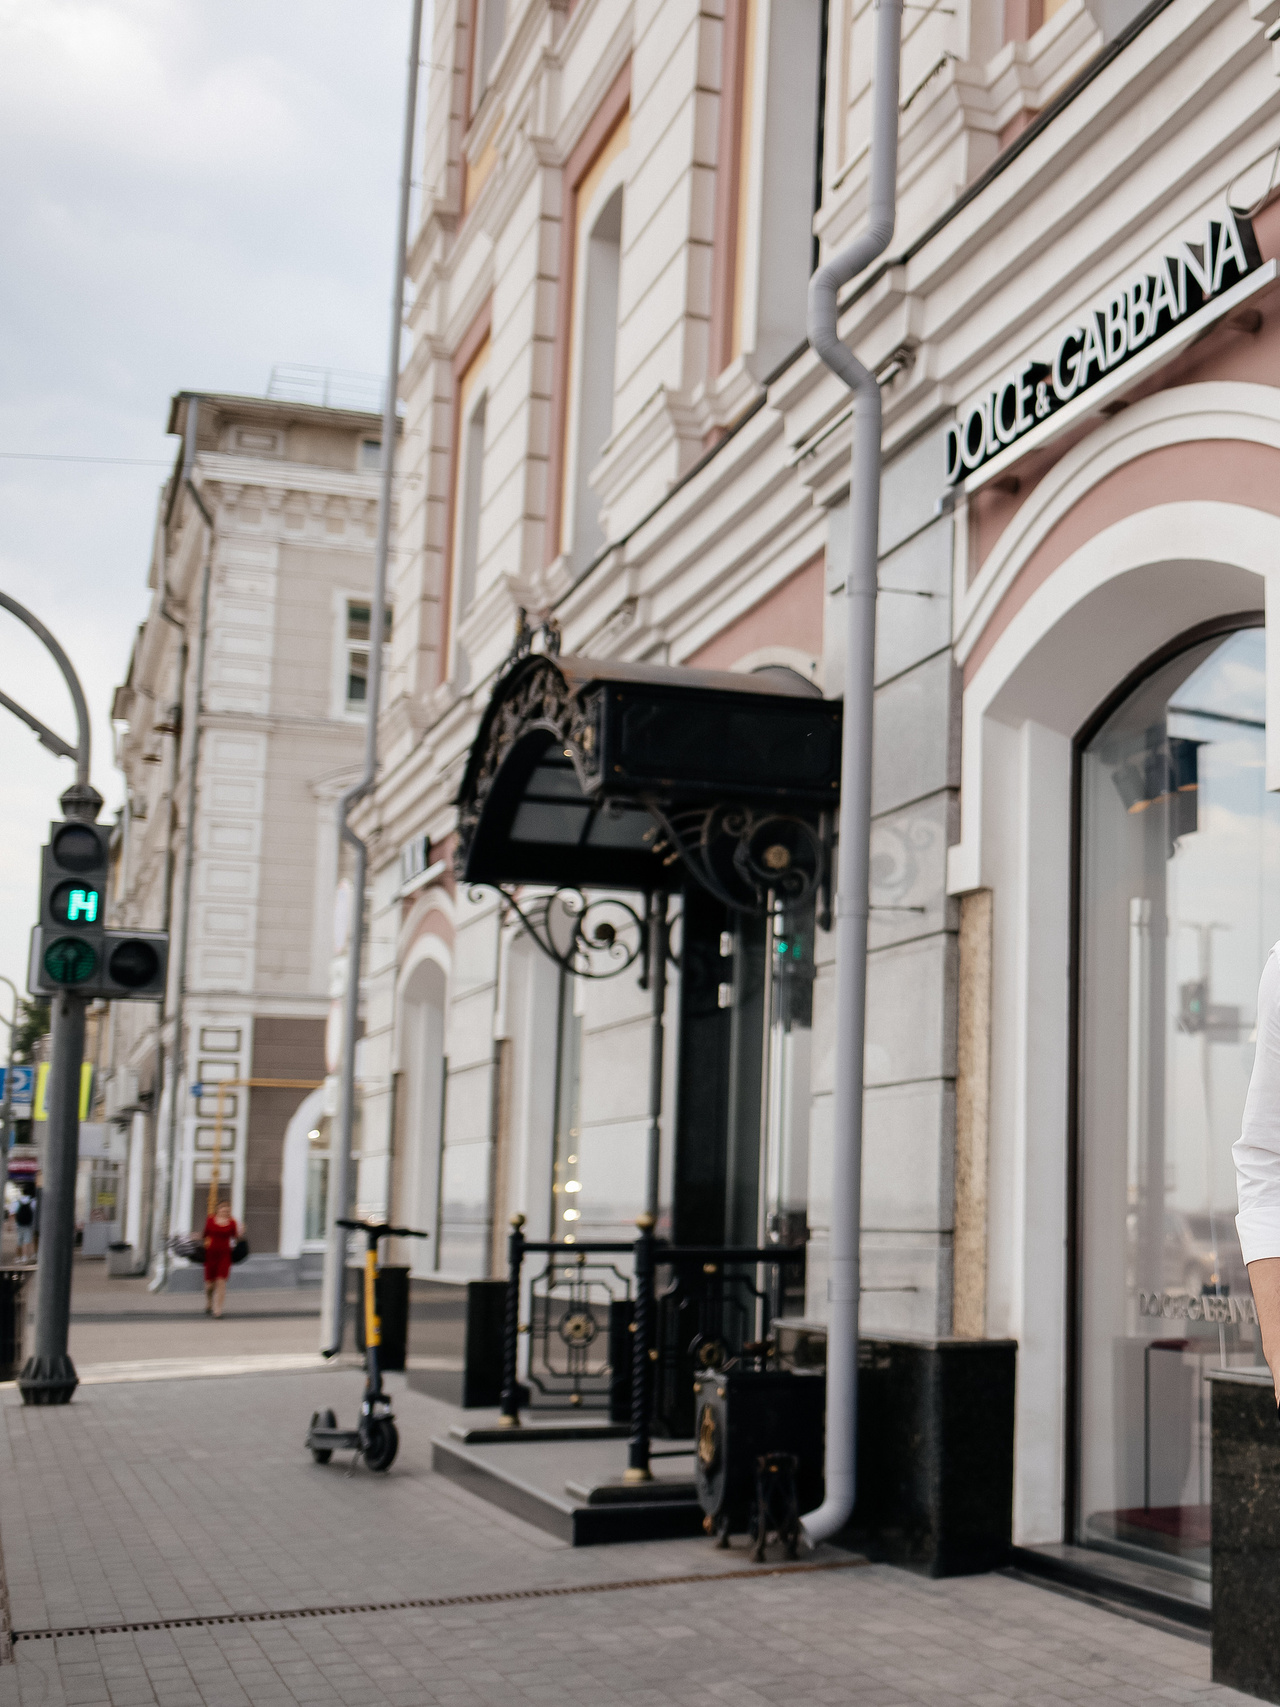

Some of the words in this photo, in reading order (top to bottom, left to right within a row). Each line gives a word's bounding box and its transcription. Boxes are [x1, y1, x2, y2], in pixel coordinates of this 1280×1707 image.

[944, 362, 1036, 487] DOLCE
[1034, 380, 1051, 418] &
[1051, 205, 1249, 401] GABBANA
